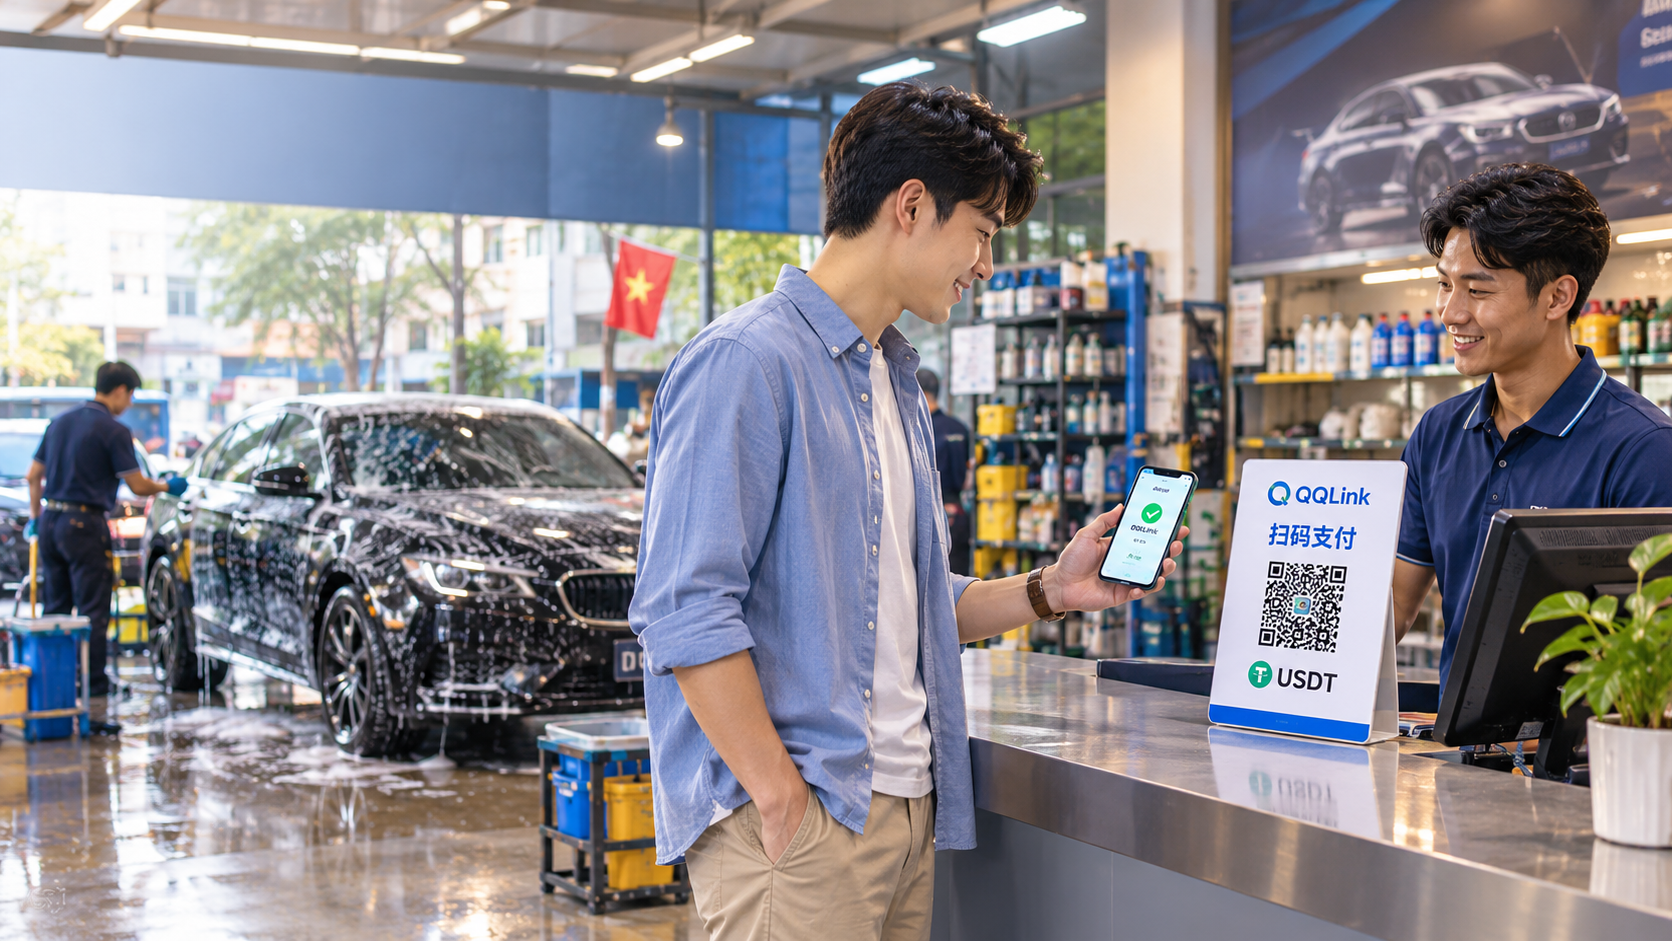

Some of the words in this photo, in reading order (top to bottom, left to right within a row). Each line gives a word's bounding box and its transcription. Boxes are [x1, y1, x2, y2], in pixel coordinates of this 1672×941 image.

[1296, 485, 1371, 506] QQLink
[1269, 523, 1357, 550] 扫码支付
[1278, 667, 1338, 693] USDT
